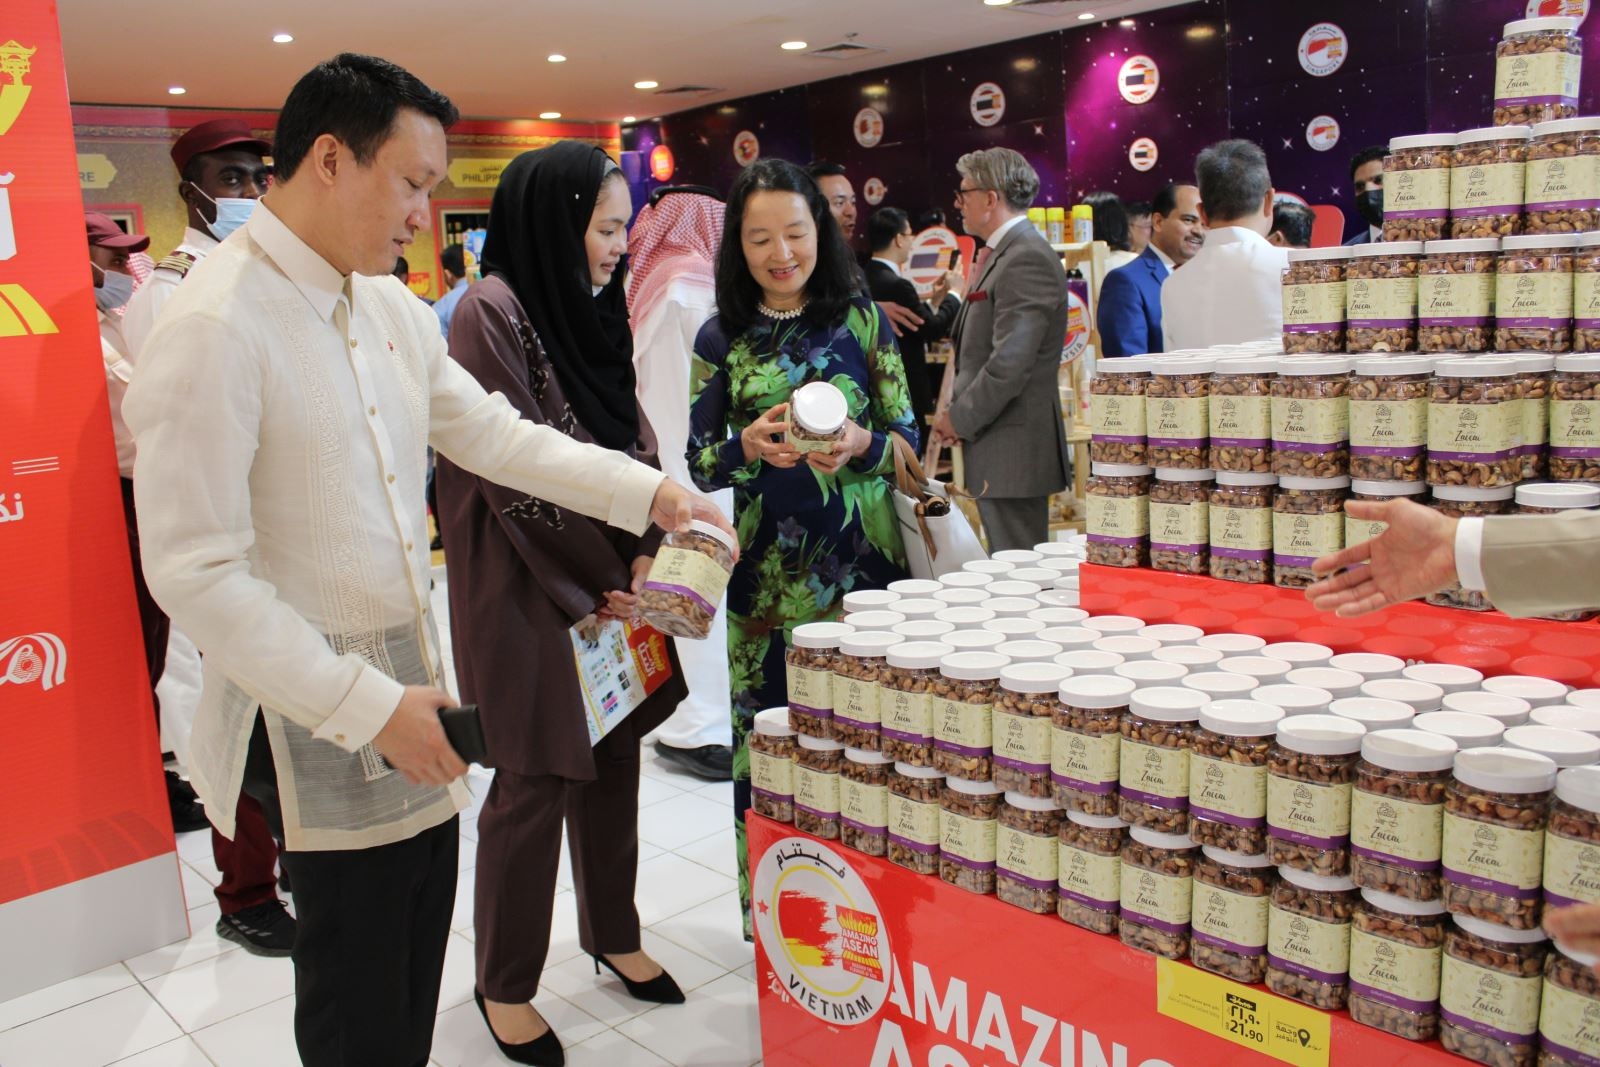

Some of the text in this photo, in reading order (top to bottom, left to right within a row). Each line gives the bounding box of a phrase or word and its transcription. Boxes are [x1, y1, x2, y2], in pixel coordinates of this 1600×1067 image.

[462, 173, 502, 183] PHILIPP
[776, 843, 846, 879] فيتنام
[842, 928, 878, 945] AMAZING
[842, 937, 879, 959] ASEAN
[789, 973, 873, 1020] VIETNAM
[888, 953, 1175, 1067] AMAZIN
[1230, 1019, 1263, 1043] 21.90
